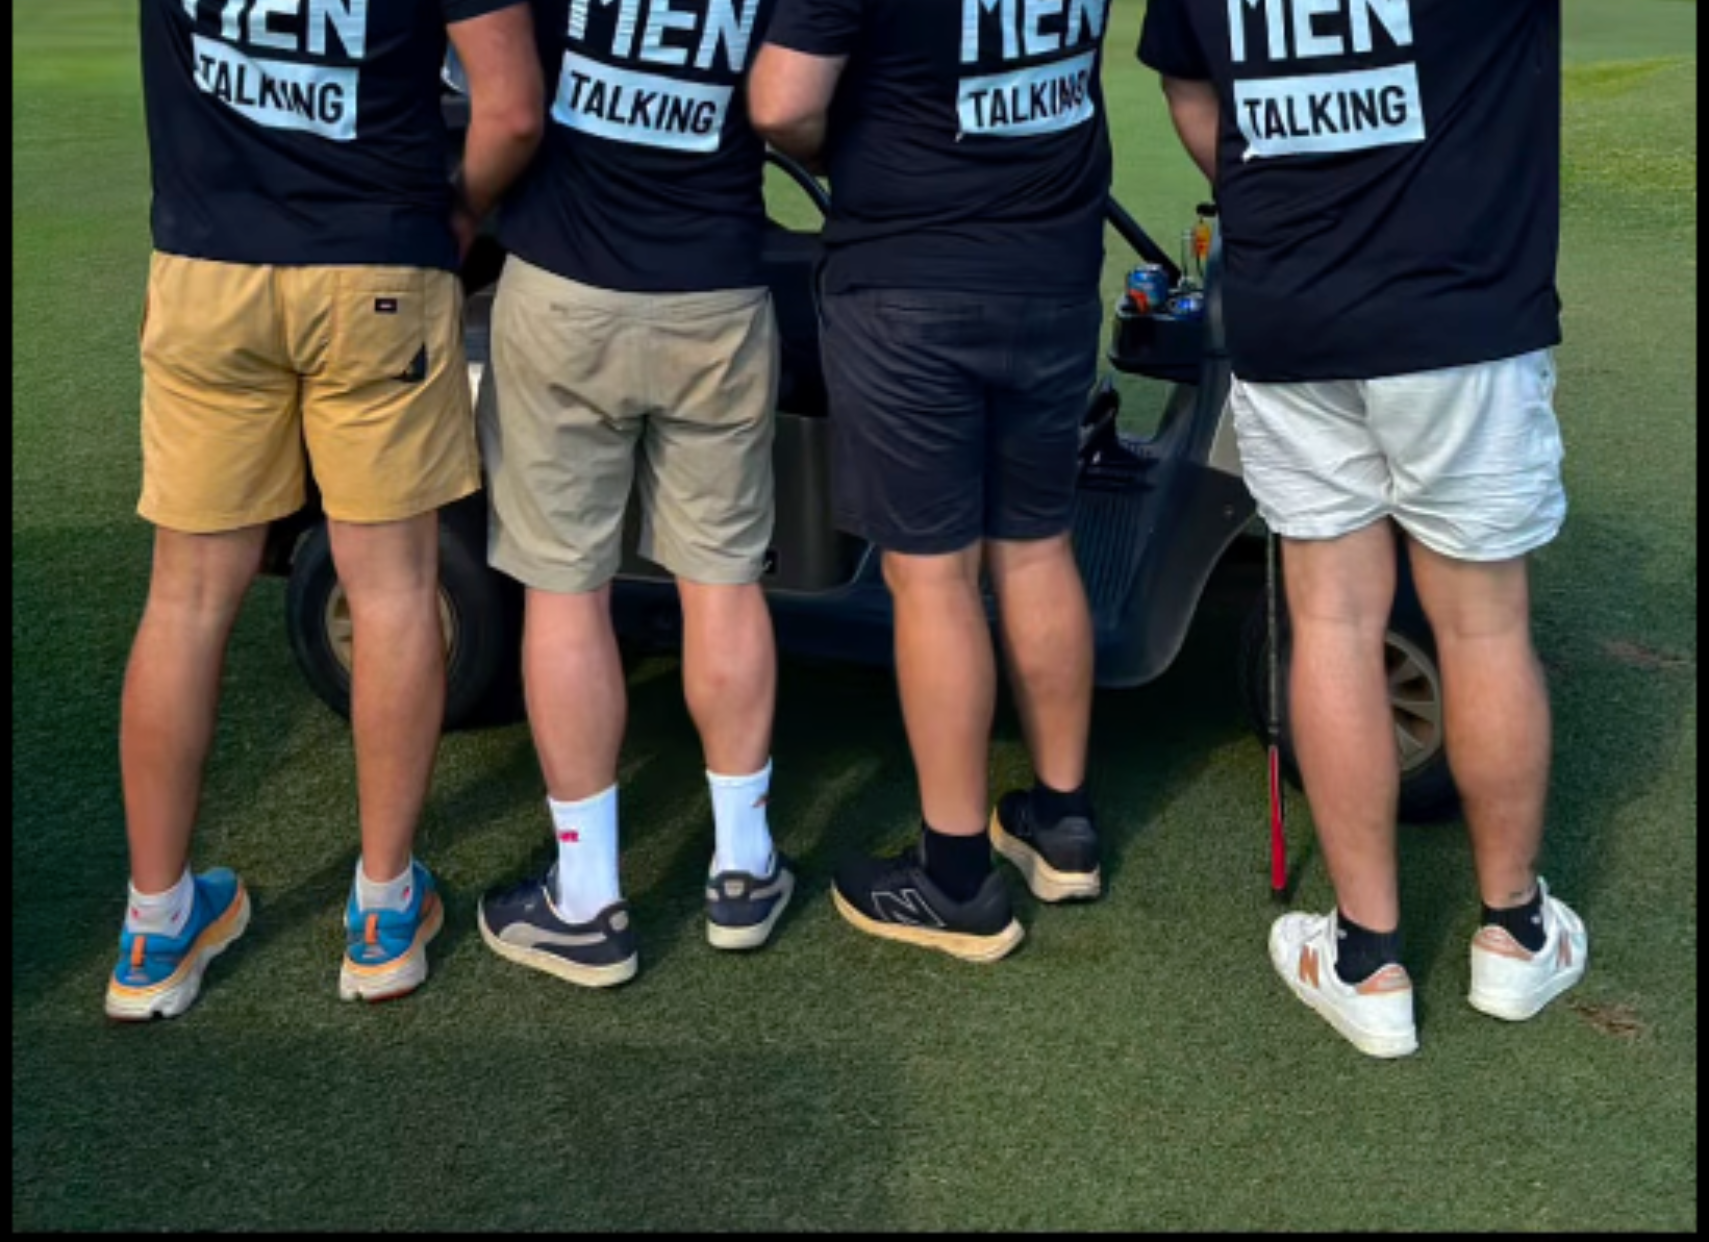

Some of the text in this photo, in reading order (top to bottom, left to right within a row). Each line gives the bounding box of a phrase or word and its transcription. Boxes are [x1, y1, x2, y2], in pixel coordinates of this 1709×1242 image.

[200, 54, 345, 124] TALKING
[569, 70, 718, 134] TALKING
[969, 70, 1089, 128] TALKING
[1243, 85, 1408, 140] TALKING
